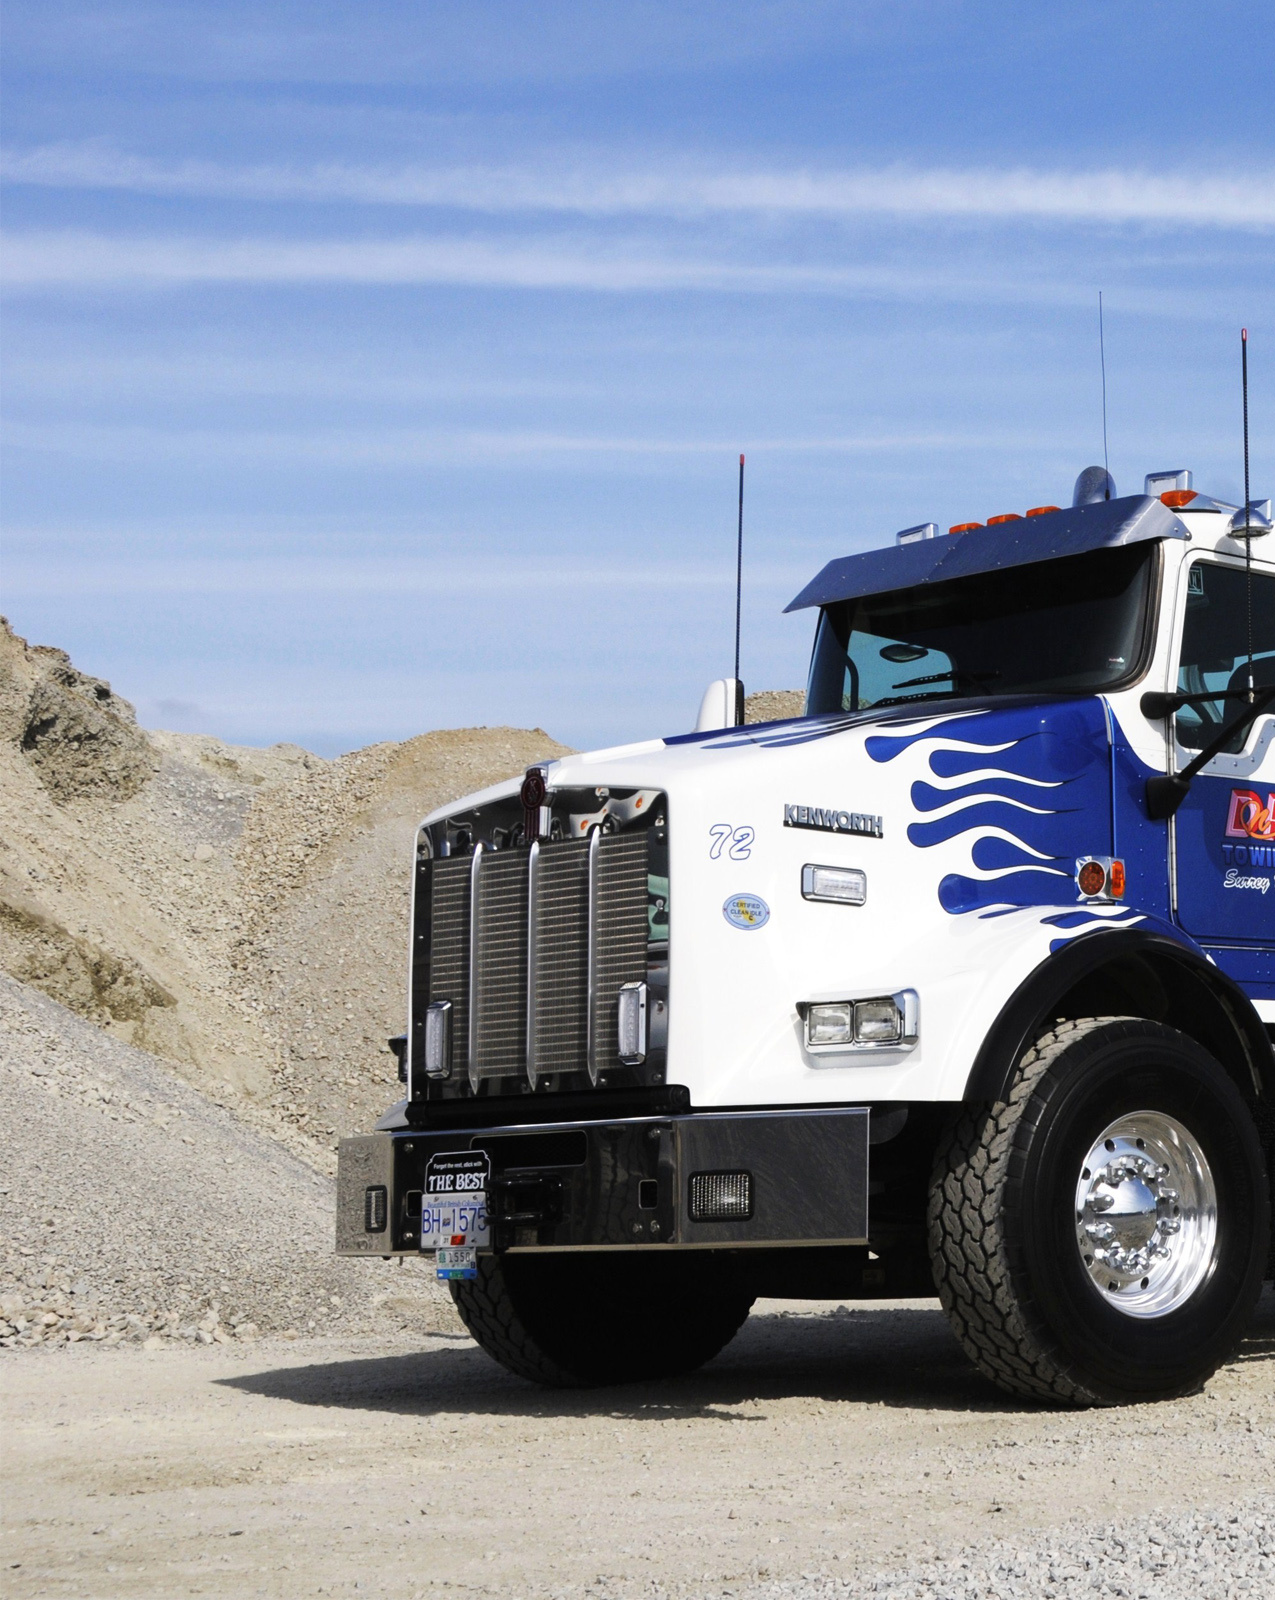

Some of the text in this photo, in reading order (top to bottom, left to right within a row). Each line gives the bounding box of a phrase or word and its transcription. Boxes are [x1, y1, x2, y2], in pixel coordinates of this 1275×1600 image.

[784, 803, 883, 833] KENWORTH
[709, 824, 755, 860] 72
[1223, 868, 1270, 894] Surrey
[732, 901, 761, 909] CERTIFIED
[428, 1172, 488, 1192] THE BEST
